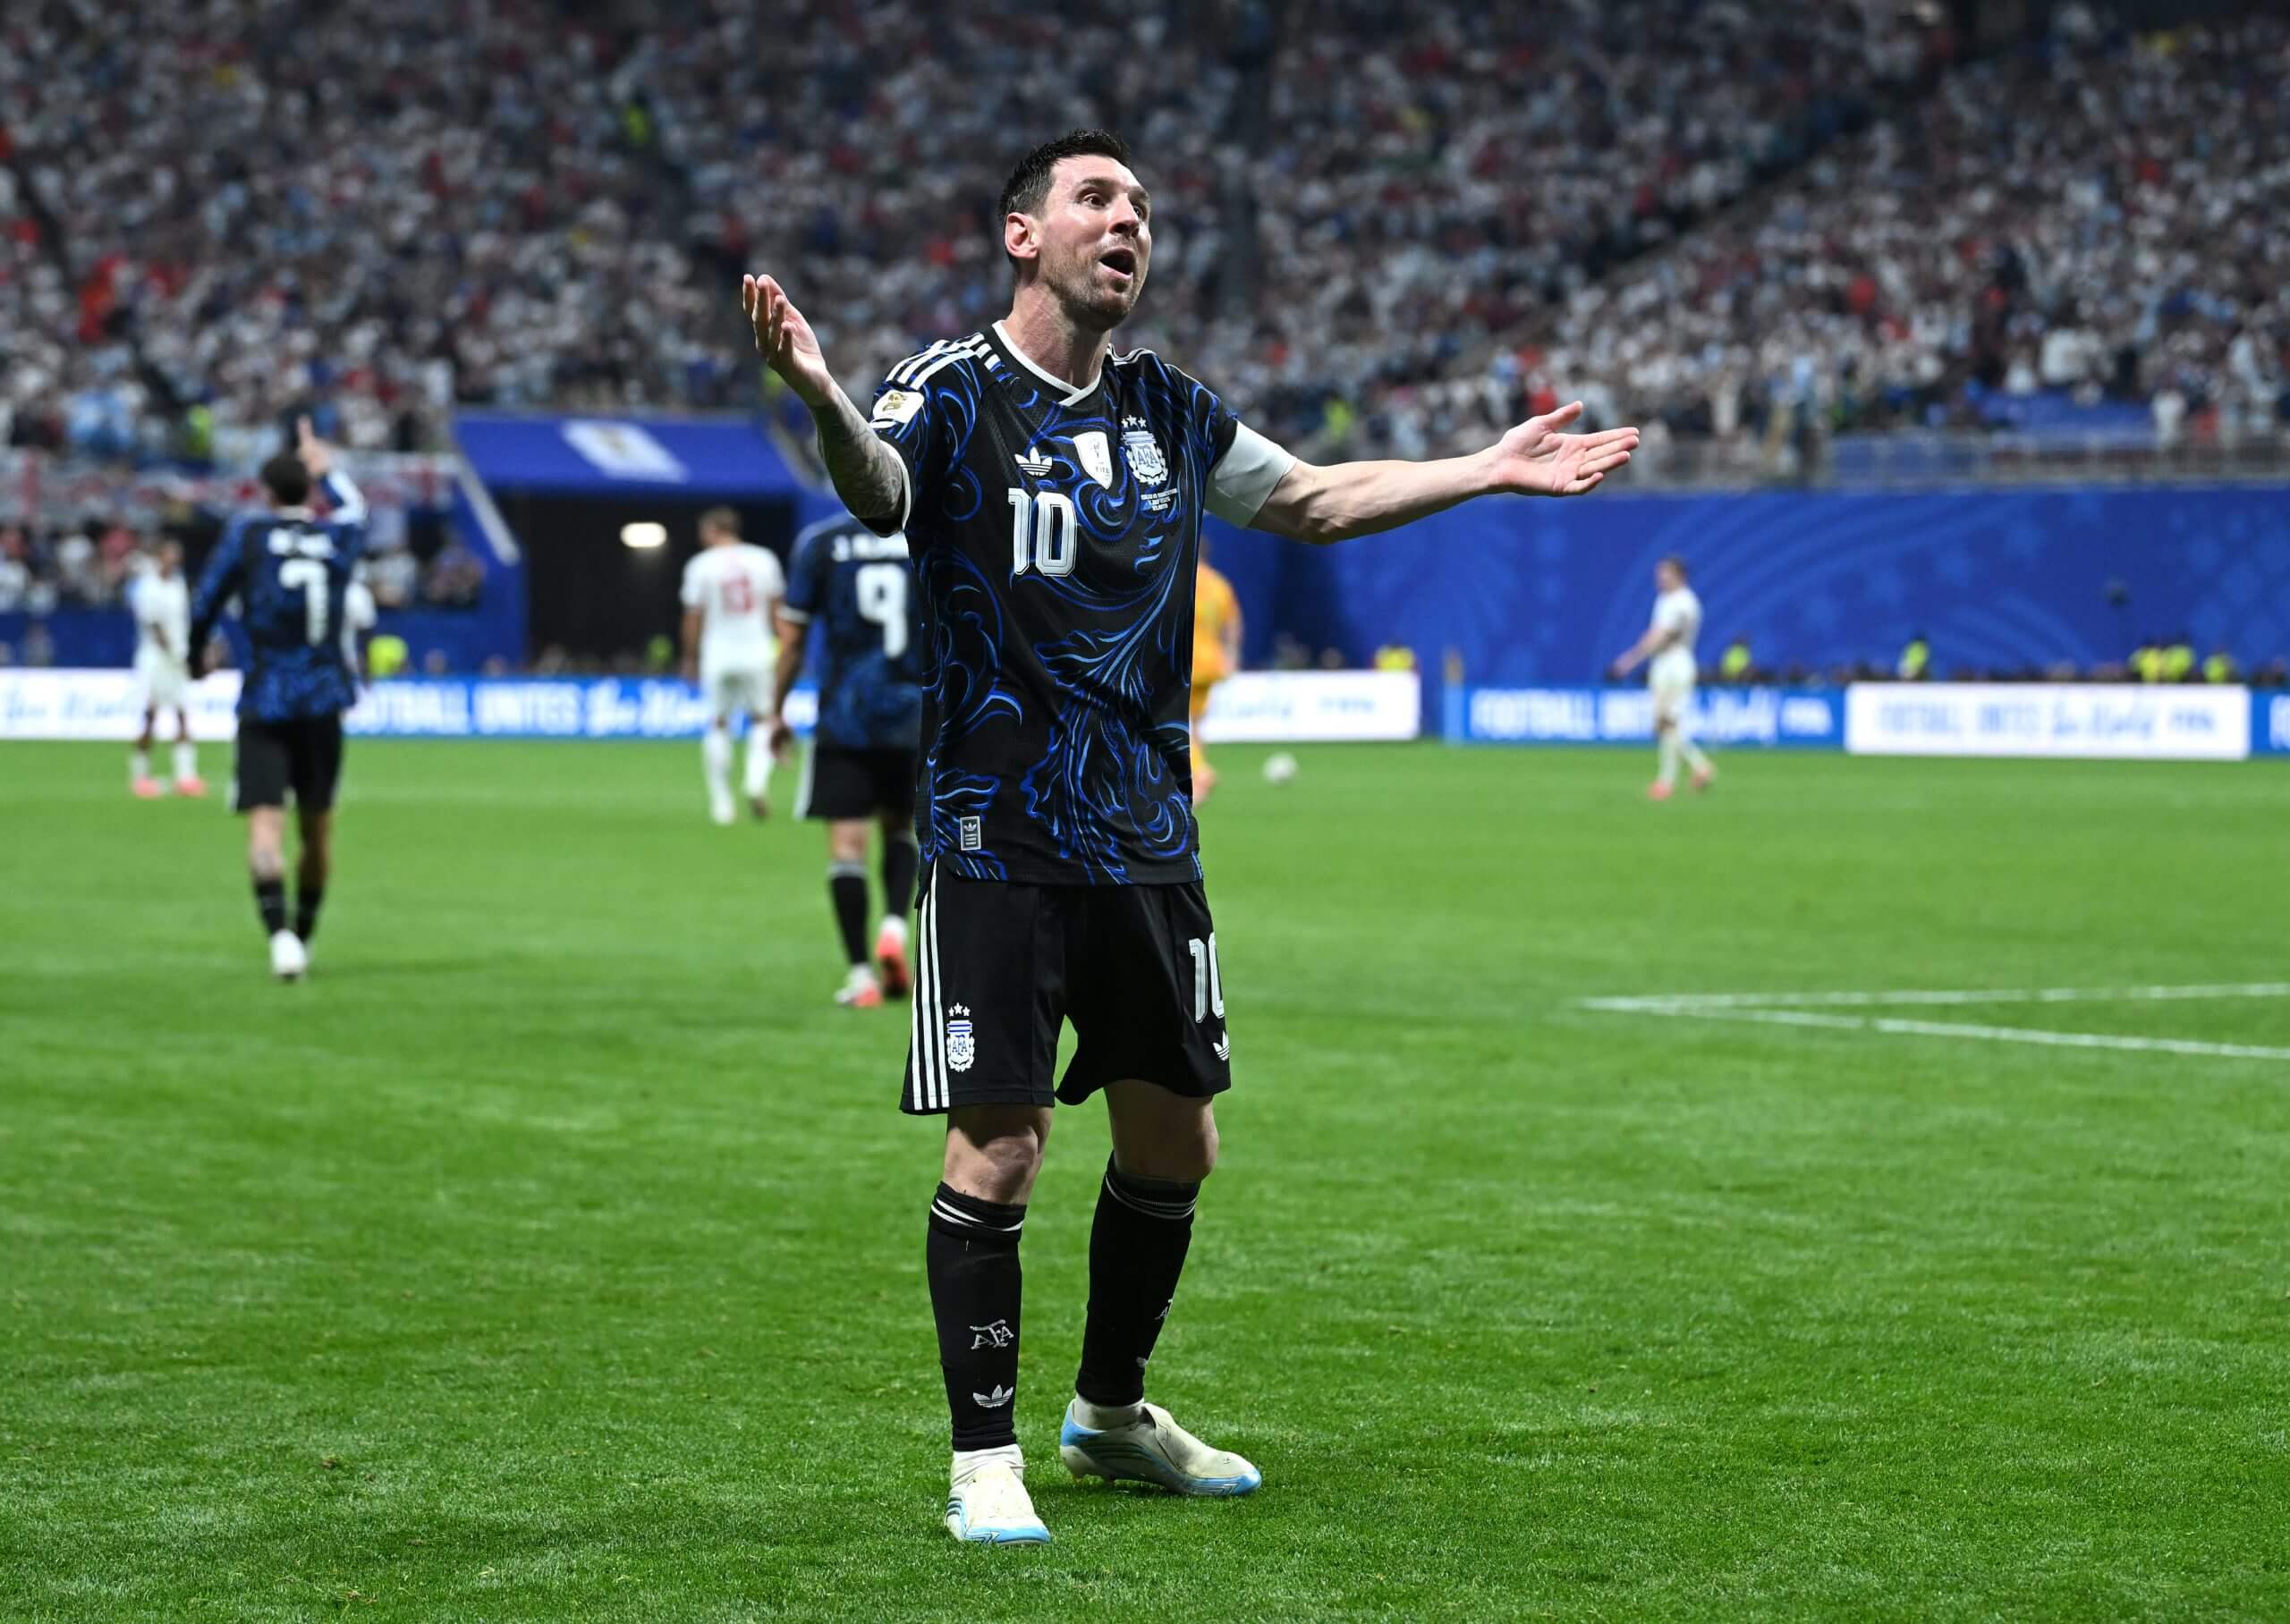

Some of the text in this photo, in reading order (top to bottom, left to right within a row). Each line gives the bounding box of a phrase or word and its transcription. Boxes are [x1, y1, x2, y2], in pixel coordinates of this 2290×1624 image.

[1007, 487, 1077, 577] 10
[278, 557, 329, 646] 7
[856, 562, 907, 659] 9
